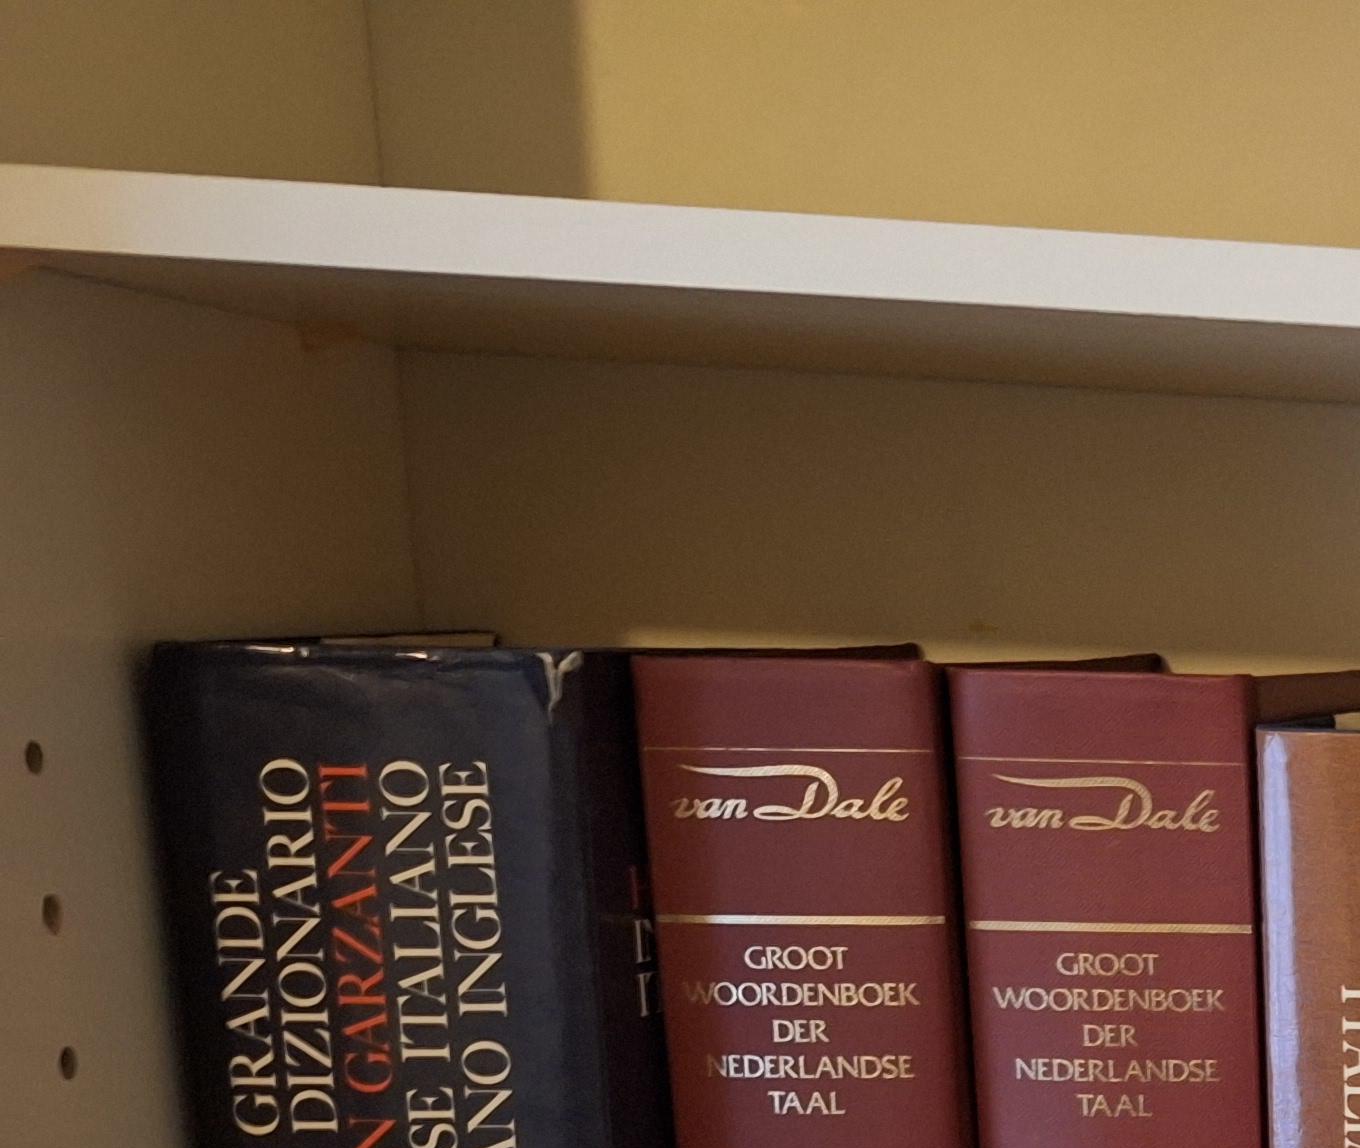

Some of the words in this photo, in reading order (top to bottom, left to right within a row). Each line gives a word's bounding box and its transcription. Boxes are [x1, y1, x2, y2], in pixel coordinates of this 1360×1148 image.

[440, 761, 509, 1018] INGLESE
[378, 759, 451, 1058] ITALIANO
[317, 762, 391, 1095] GARZANTI
[257, 756, 340, 1135] DIZIONARIO
[743, 944, 849, 972] GROOT
[1056, 951, 1159, 978] GROOT
[210, 868, 279, 1137] GRANDE
[991, 986, 1227, 1015] WOORDENBOEK
[771, 1018, 831, 1045] DER
[1081, 1024, 1138, 1049] DER
[1014, 1057, 1221, 1085] NEDERLANDSE
[767, 1091, 846, 1117] TAAL
[1075, 1093, 1154, 1118] TAAL
